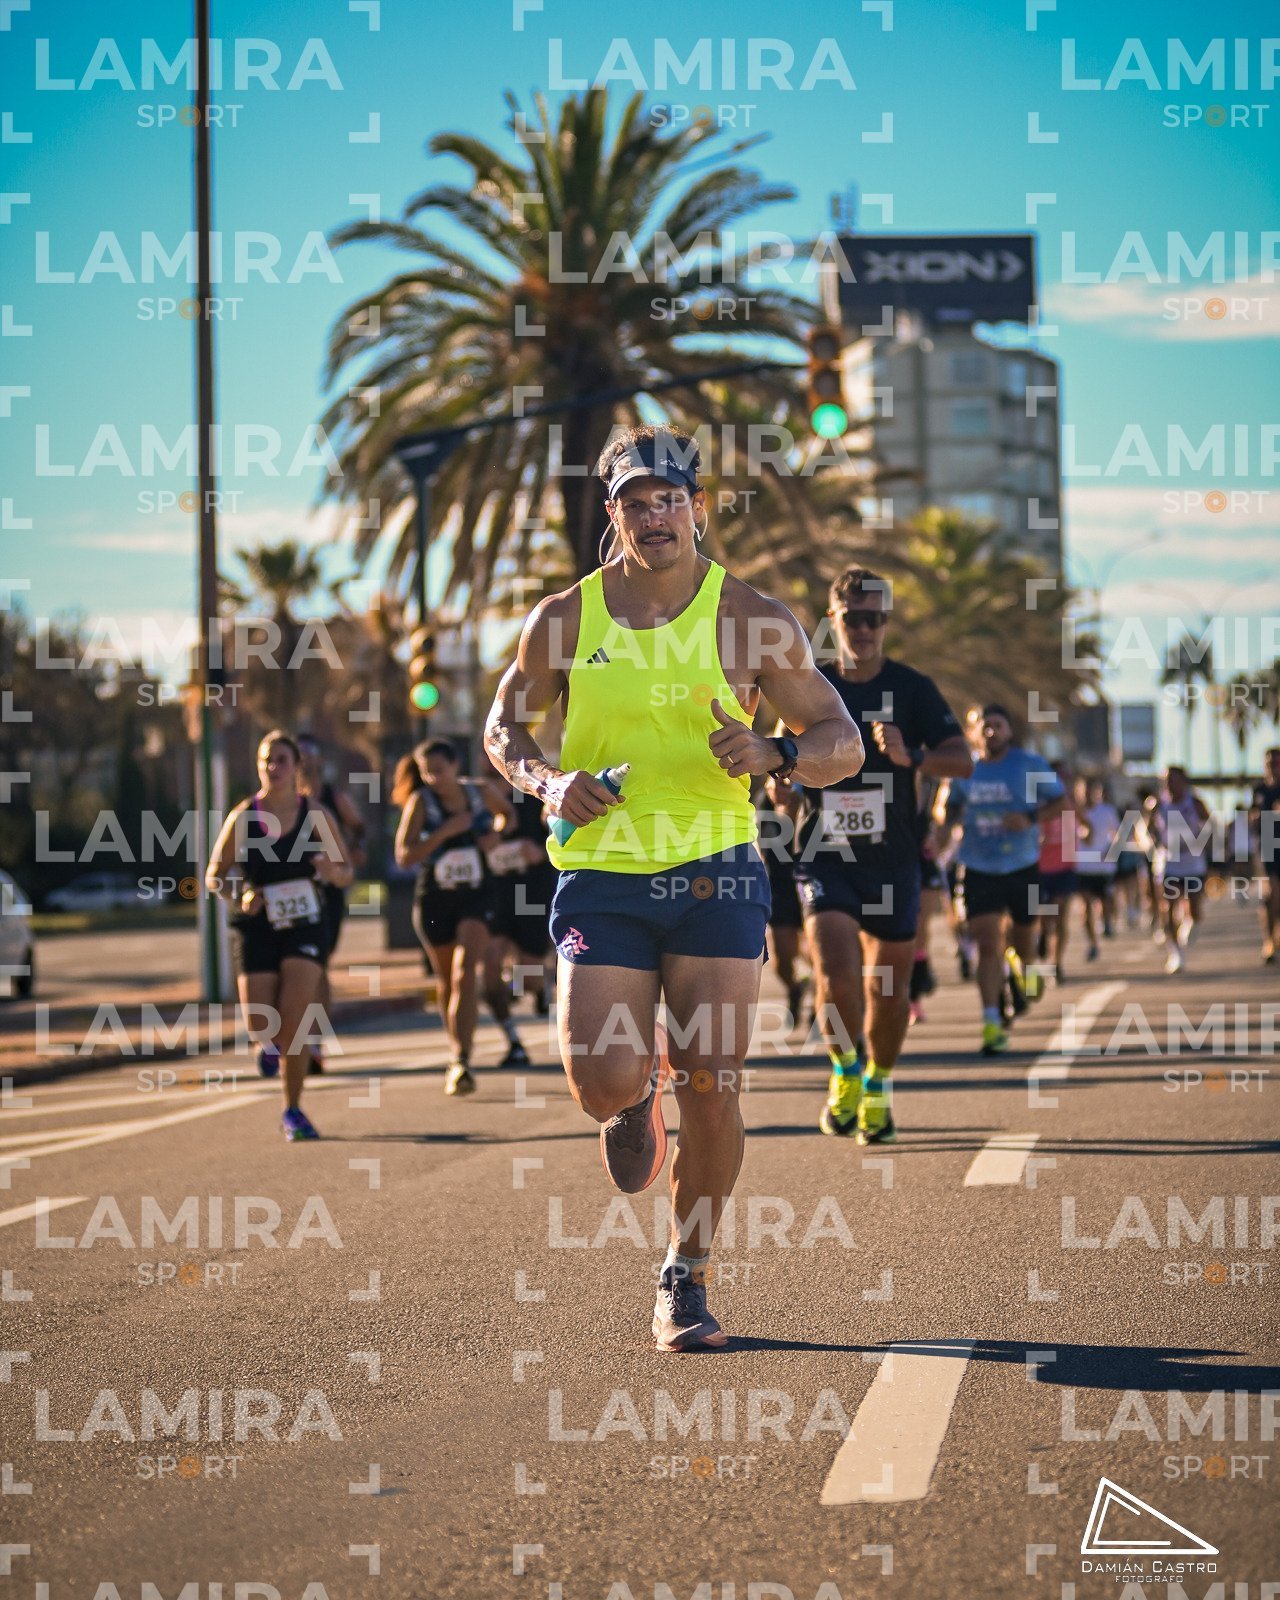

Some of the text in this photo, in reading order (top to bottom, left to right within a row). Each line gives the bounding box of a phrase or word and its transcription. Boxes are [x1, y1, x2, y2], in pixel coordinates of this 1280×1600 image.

[864, 251, 997, 283] XION
[834, 810, 875, 831] 286
[275, 895, 309, 917] 325
